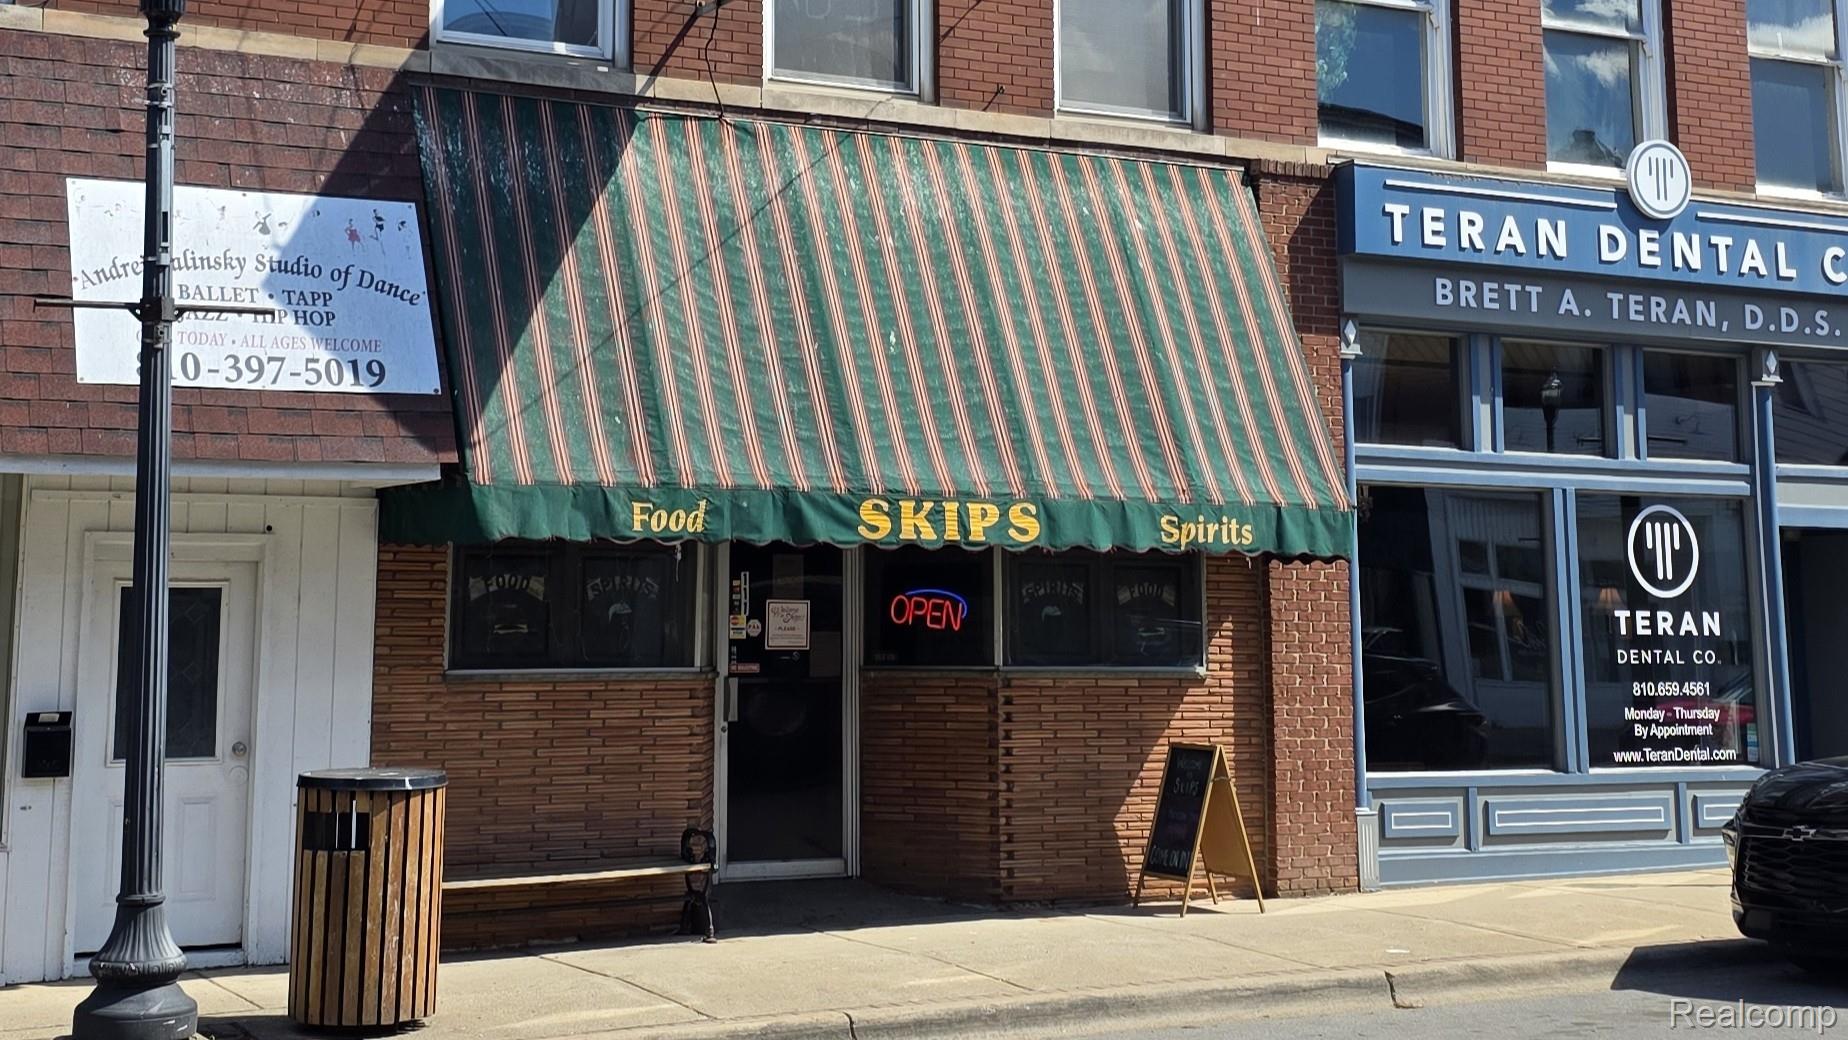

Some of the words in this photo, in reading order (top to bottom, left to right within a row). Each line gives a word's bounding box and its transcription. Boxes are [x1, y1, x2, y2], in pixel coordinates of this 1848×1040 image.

[1384, 203, 1568, 258] TERAN
[1599, 224, 1797, 278] DENTAL
[171, 248, 247, 280] alinsky
[254, 253, 323, 279] Studio
[330, 264, 355, 292] of
[356, 269, 421, 306] Dance
[179, 283, 259, 304] BALLET
[282, 289, 333, 307] TAPP
[1435, 277, 1543, 313] BRETT
[1558, 288, 1592, 317] A.
[1606, 291, 1729, 332] TERAN,
[1744, 303, 1841, 337] D.D.S.
[294, 310, 336, 327] HOP
[177, 331, 228, 346] TODAY
[240, 334, 266, 349] ALL
[271, 335, 307, 351] AGES
[311, 337, 383, 353] WELCOME
[136, 351, 387, 389] 0-397-5019
[631, 498, 709, 533] Food
[857, 498, 1042, 544] SKIPS
[1160, 514, 1254, 551] Spirits
[890, 594, 964, 632] OPEN
[1614, 609, 1721, 636] TERAN
[1616, 649, 1685, 665] DENTAL
[1692, 649, 1722, 665] CO.
[1632, 681, 1710, 697] 810.659.4561
[1624, 706, 1665, 723] Monday
[1673, 706, 1721, 723] Thursday
[1634, 723, 1649, 740] By
[1649, 723, 1713, 740] Appointment
[1613, 746, 1738, 763] www.TeranDental.com
